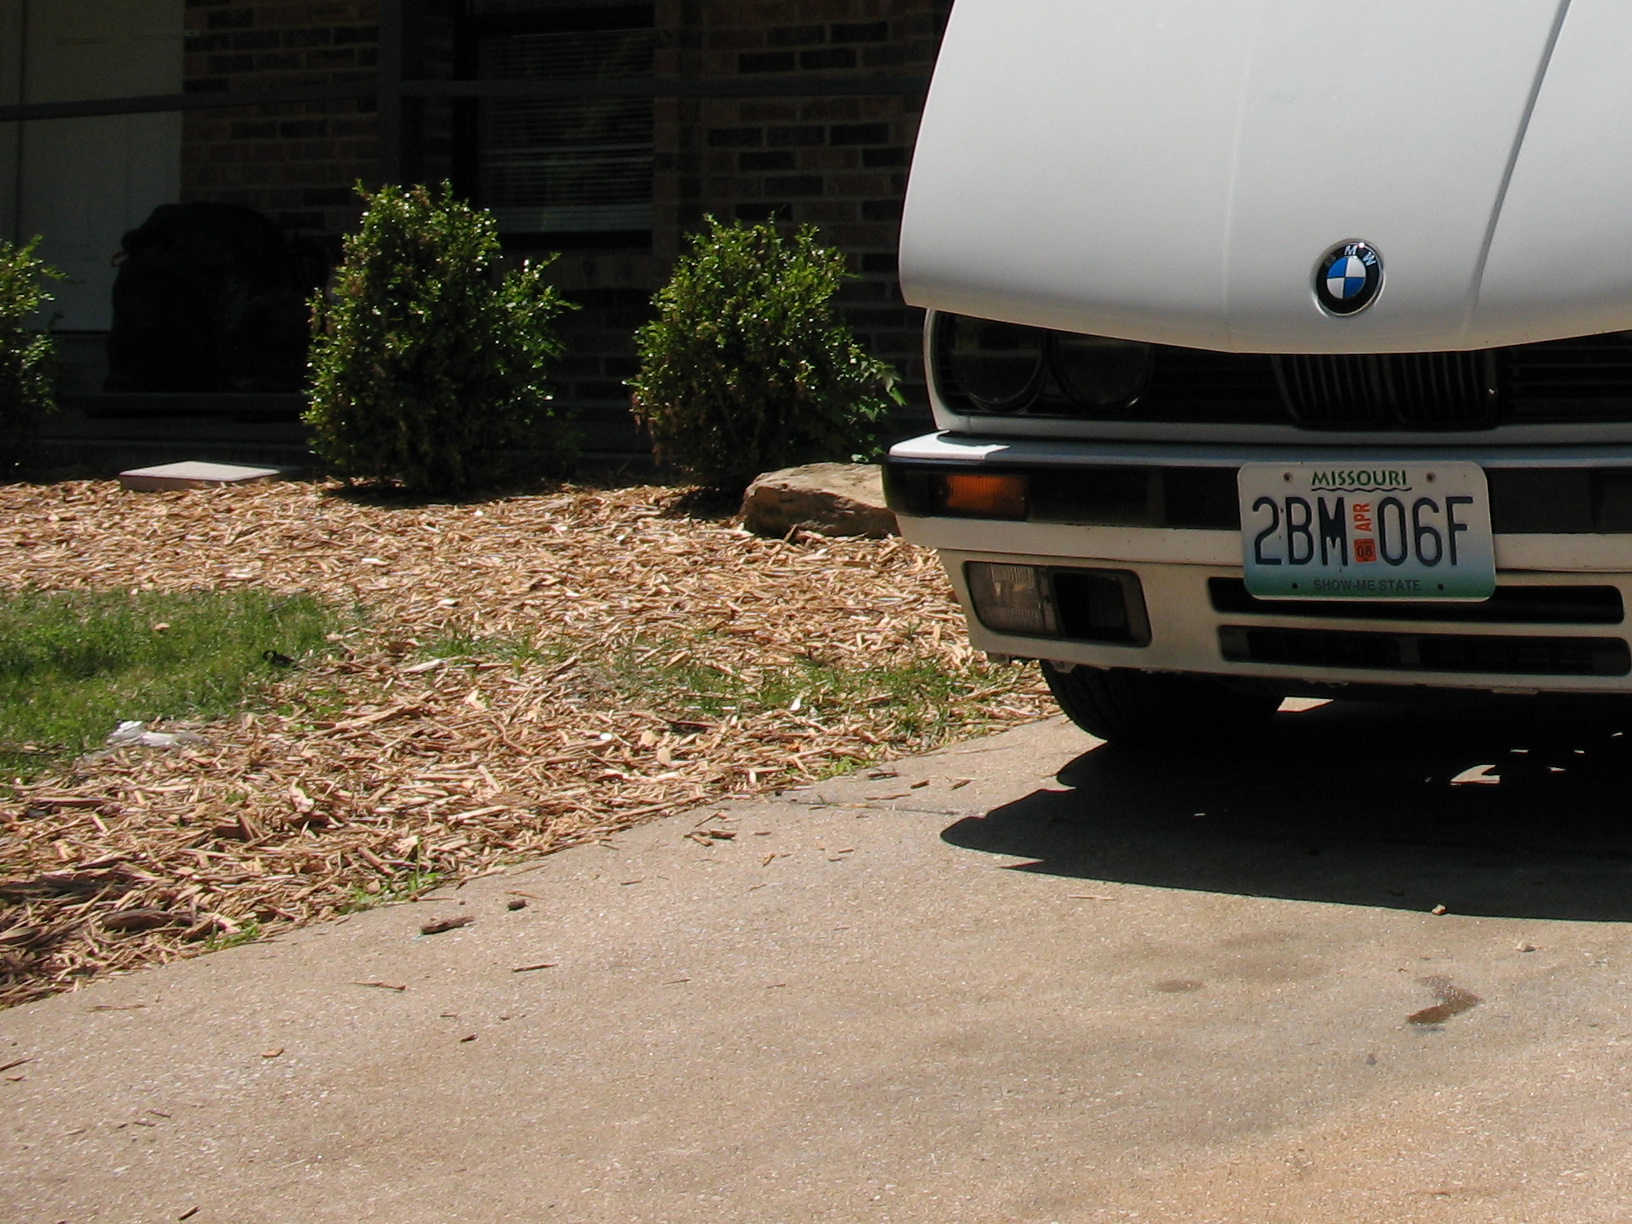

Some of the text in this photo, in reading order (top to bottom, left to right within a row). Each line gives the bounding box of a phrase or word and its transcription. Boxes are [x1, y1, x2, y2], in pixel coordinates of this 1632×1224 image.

[1325, 245, 1377, 267] BMW
[1311, 470, 1407, 486] MISSOURI
[1353, 502, 1372, 533] APR
[1252, 496, 1474, 567] 2BM 06F
[1313, 579, 1422, 591] SHOW-ME STATE
